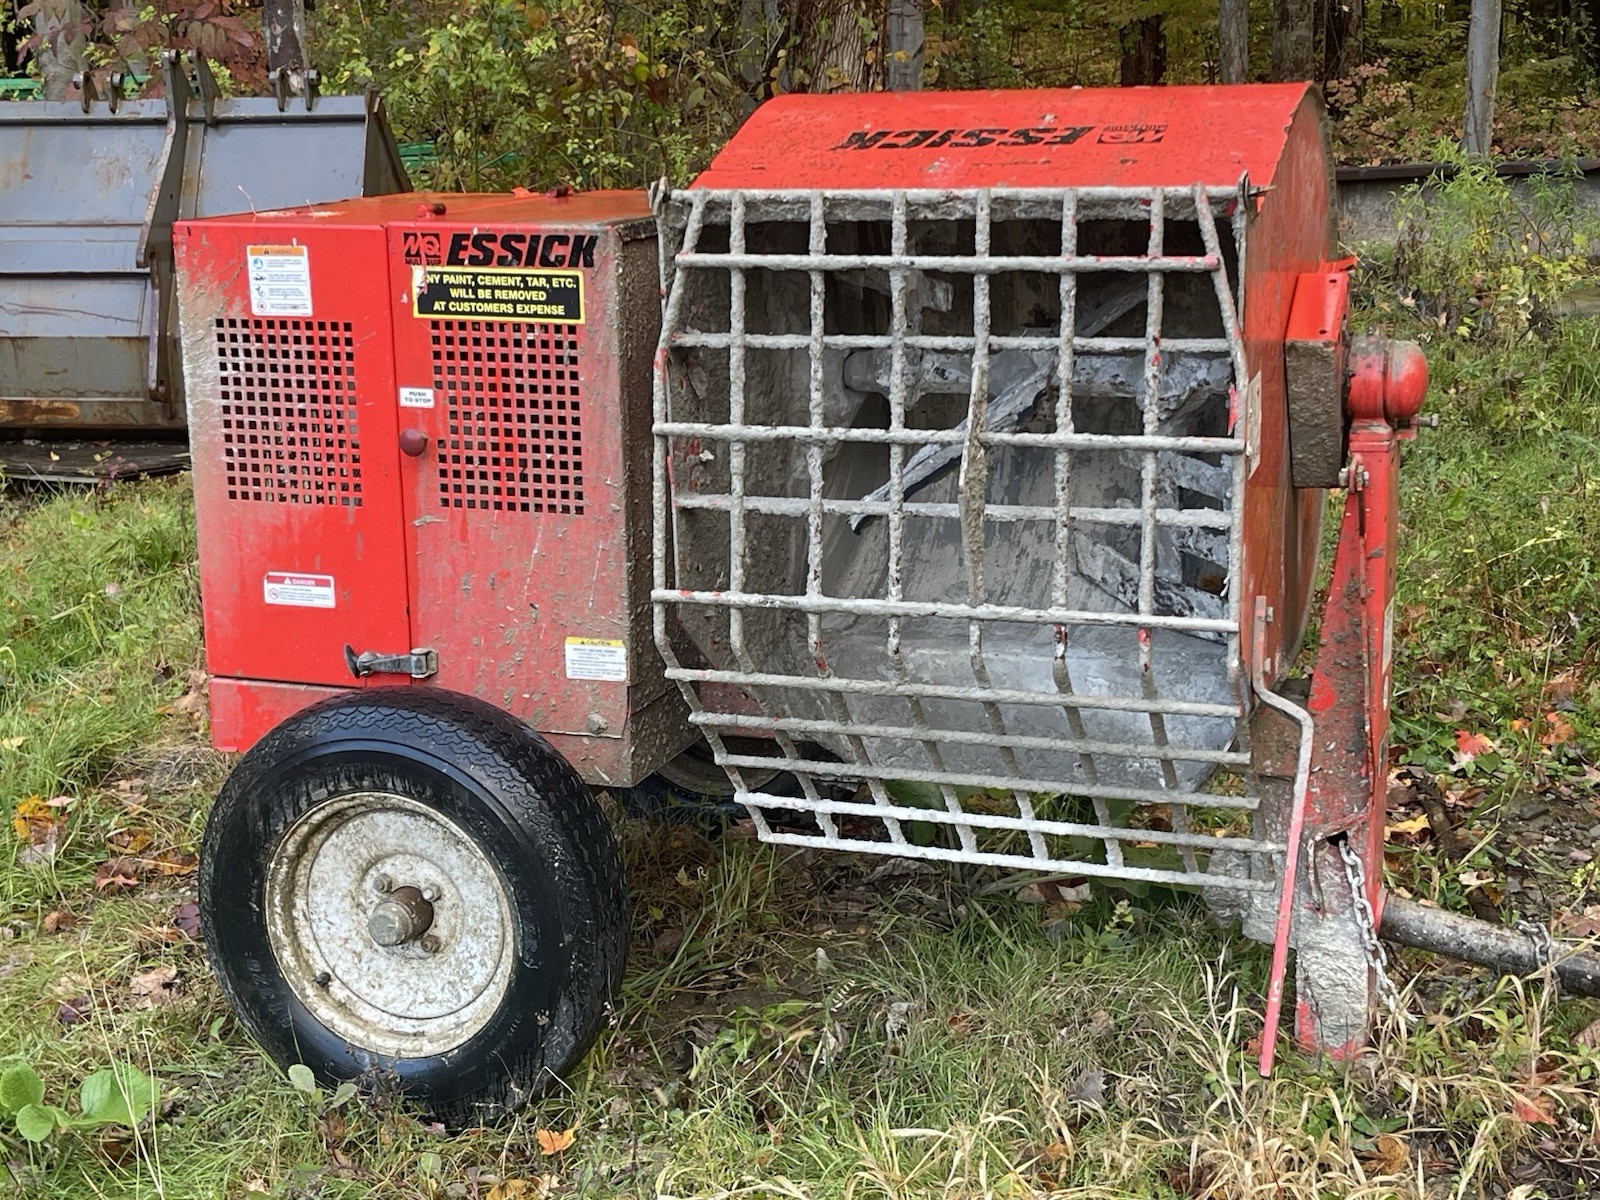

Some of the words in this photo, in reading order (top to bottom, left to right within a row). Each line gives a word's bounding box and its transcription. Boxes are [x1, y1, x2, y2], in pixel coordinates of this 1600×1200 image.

[832, 126, 1095, 150] ESSICK
[404, 232, 441, 258] MQ
[446, 233, 599, 267] ESSICK
[426, 274, 441, 284] NY
[443, 274, 475, 286] PAINT,
[477, 275, 524, 288] CEMENT,
[526, 277, 550, 289] TAR,
[552, 278, 577, 289] ETC.
[450, 289, 476, 298] WILL
[477, 289, 492, 299] BE
[494, 290, 547, 300] REMOVED
[433, 302, 447, 311] AT
[448, 302, 514, 313] CUSTOMERS
[516, 304, 565, 315] EXPENSE
